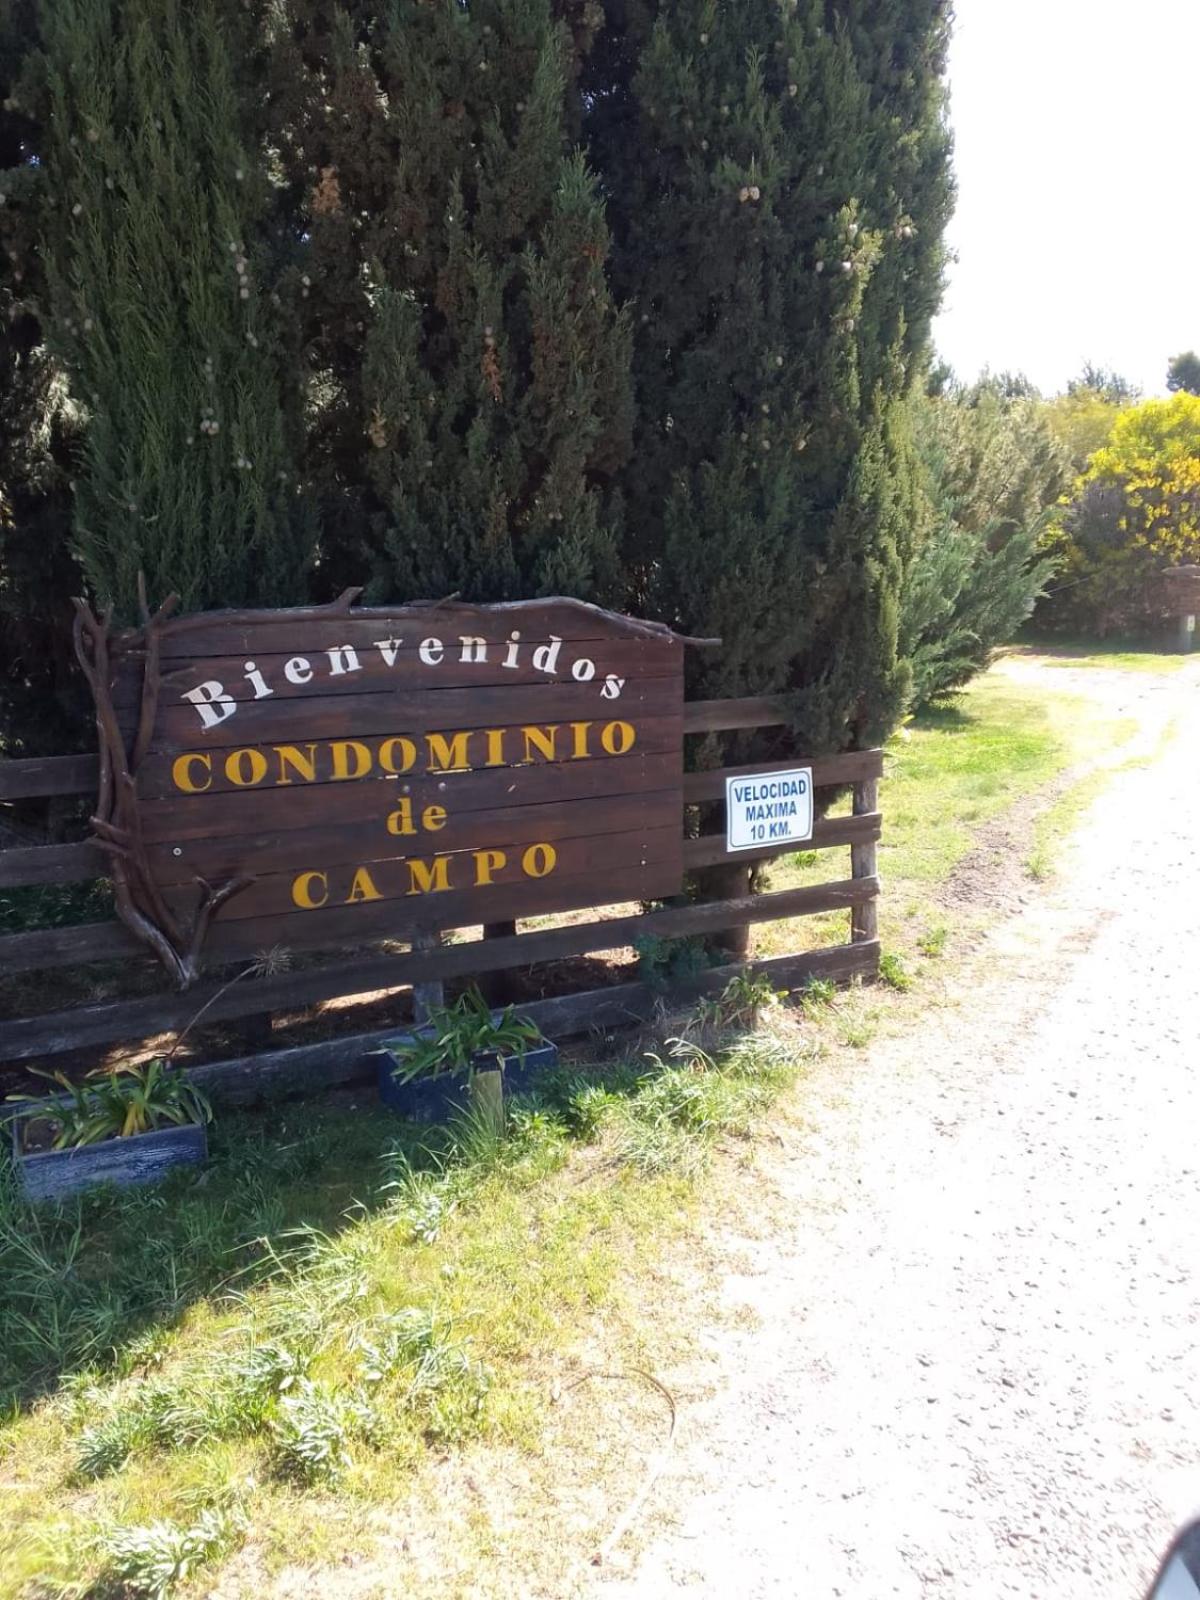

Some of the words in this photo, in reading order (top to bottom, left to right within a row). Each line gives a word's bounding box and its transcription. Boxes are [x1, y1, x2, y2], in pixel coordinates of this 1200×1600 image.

[180, 630, 626, 730] Bienvenidos
[171, 720, 637, 794] CONDOMINIO
[734, 779, 807, 803] VELOCIDAD
[745, 800, 797, 822] MAXIMA
[386, 796, 449, 836] de
[750, 823, 765, 841] 10
[769, 820, 792, 838] KM.
[291, 842, 557, 909] CAMPO
